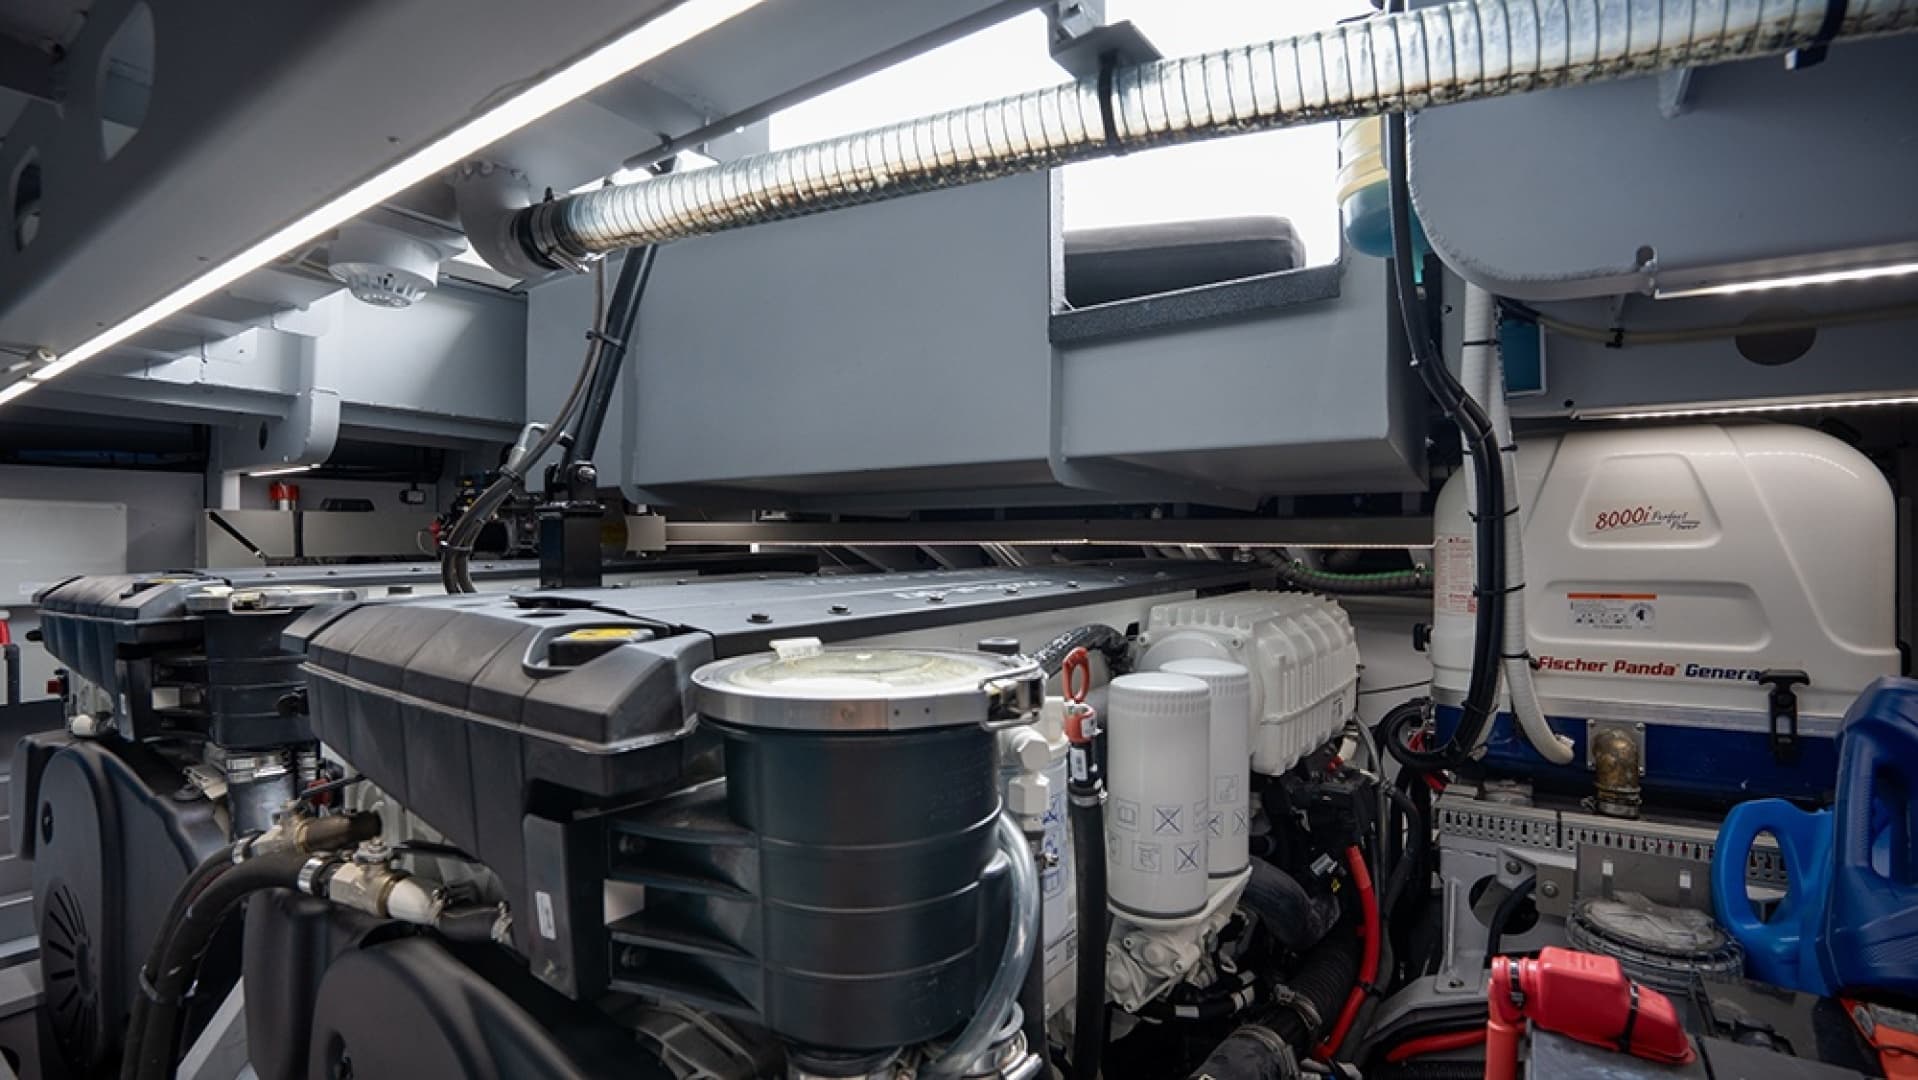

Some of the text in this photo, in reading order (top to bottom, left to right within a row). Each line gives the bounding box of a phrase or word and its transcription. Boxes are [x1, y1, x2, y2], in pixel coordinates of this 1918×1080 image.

[1595, 505, 1653, 530] 8000i
[1537, 655, 1762, 682] Fischer Panda Genera
